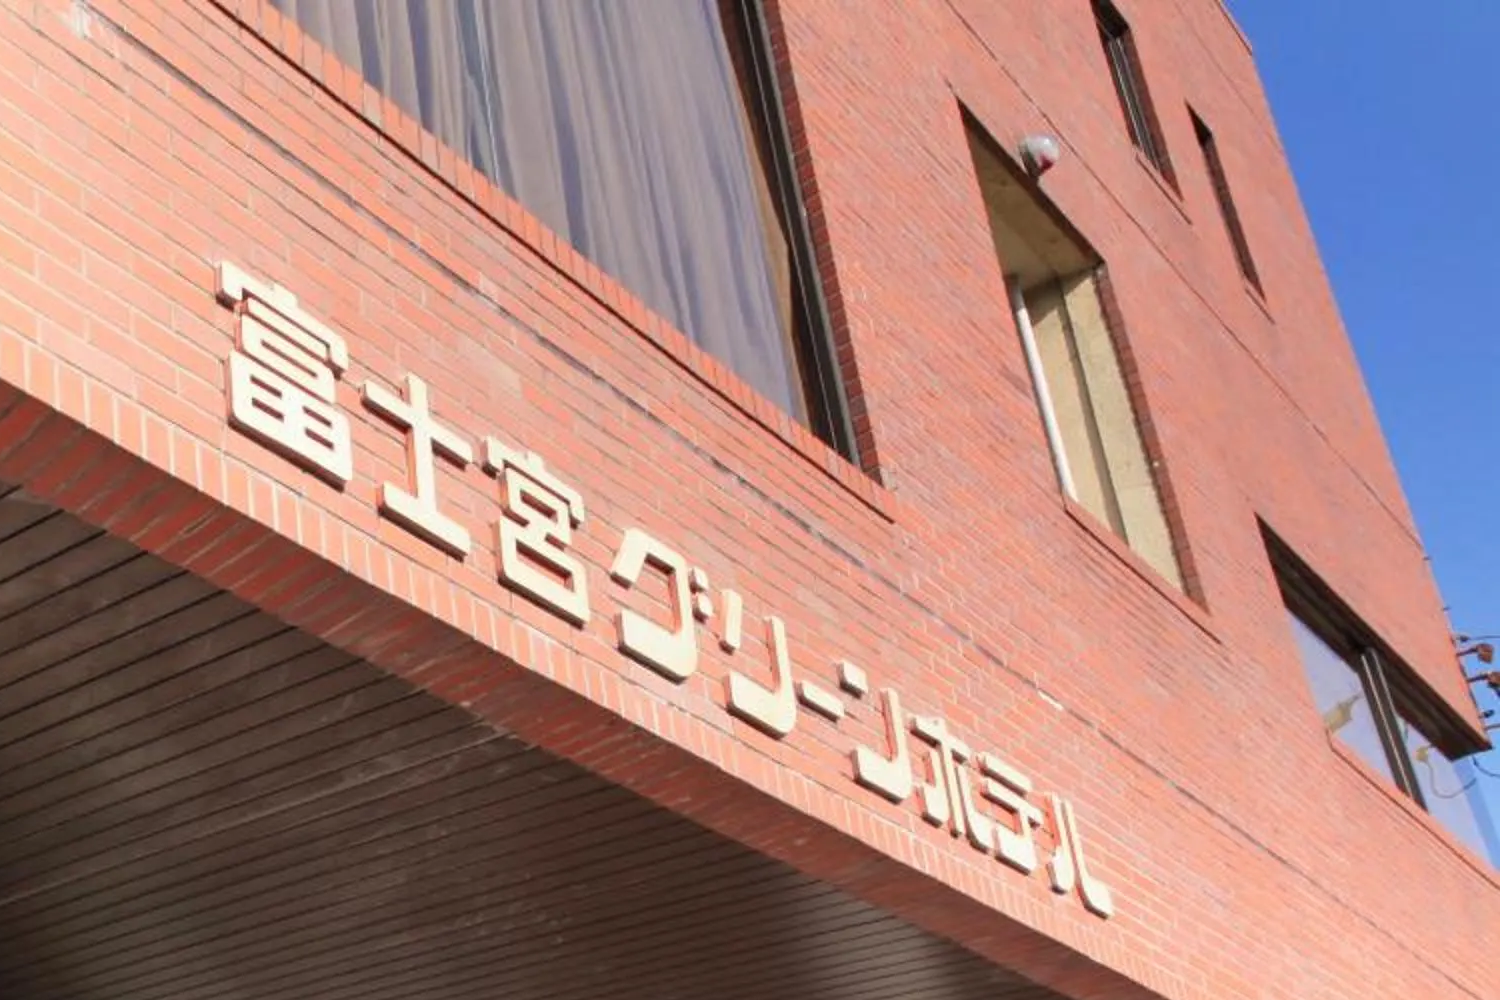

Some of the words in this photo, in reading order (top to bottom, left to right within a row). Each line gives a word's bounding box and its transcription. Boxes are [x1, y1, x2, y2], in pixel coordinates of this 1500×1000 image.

[215, 261, 1114, 920] 富士宮グリーンホテル
